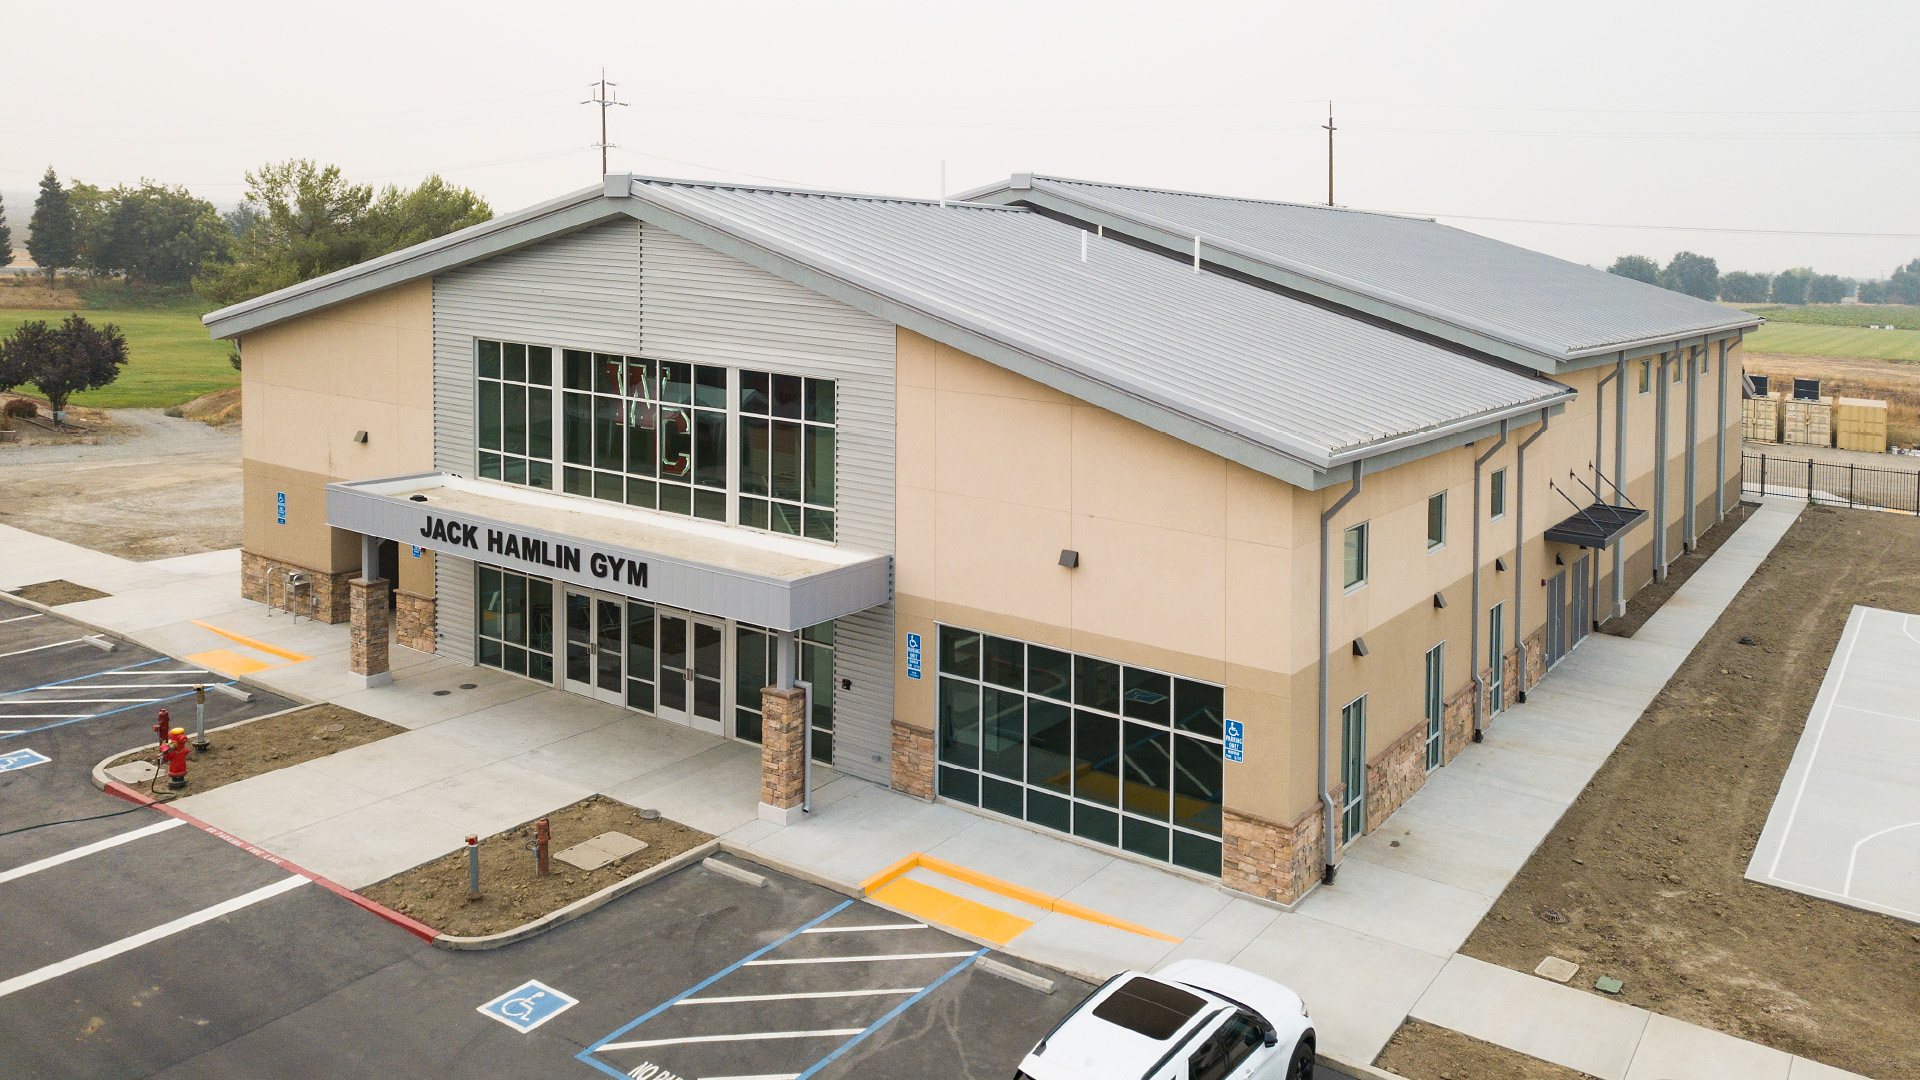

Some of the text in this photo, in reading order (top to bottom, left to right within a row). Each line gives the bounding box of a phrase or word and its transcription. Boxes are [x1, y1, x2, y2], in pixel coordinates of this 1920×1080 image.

[420, 516, 648, 588] JACK HAMLIN GYM
[1226, 735, 1243, 744] PARKING
[216, 832, 243, 846] PARKING
[246, 846, 265, 856] FIRE
[263, 854, 284, 864] LANE
[627, 1061, 660, 1080] NO
